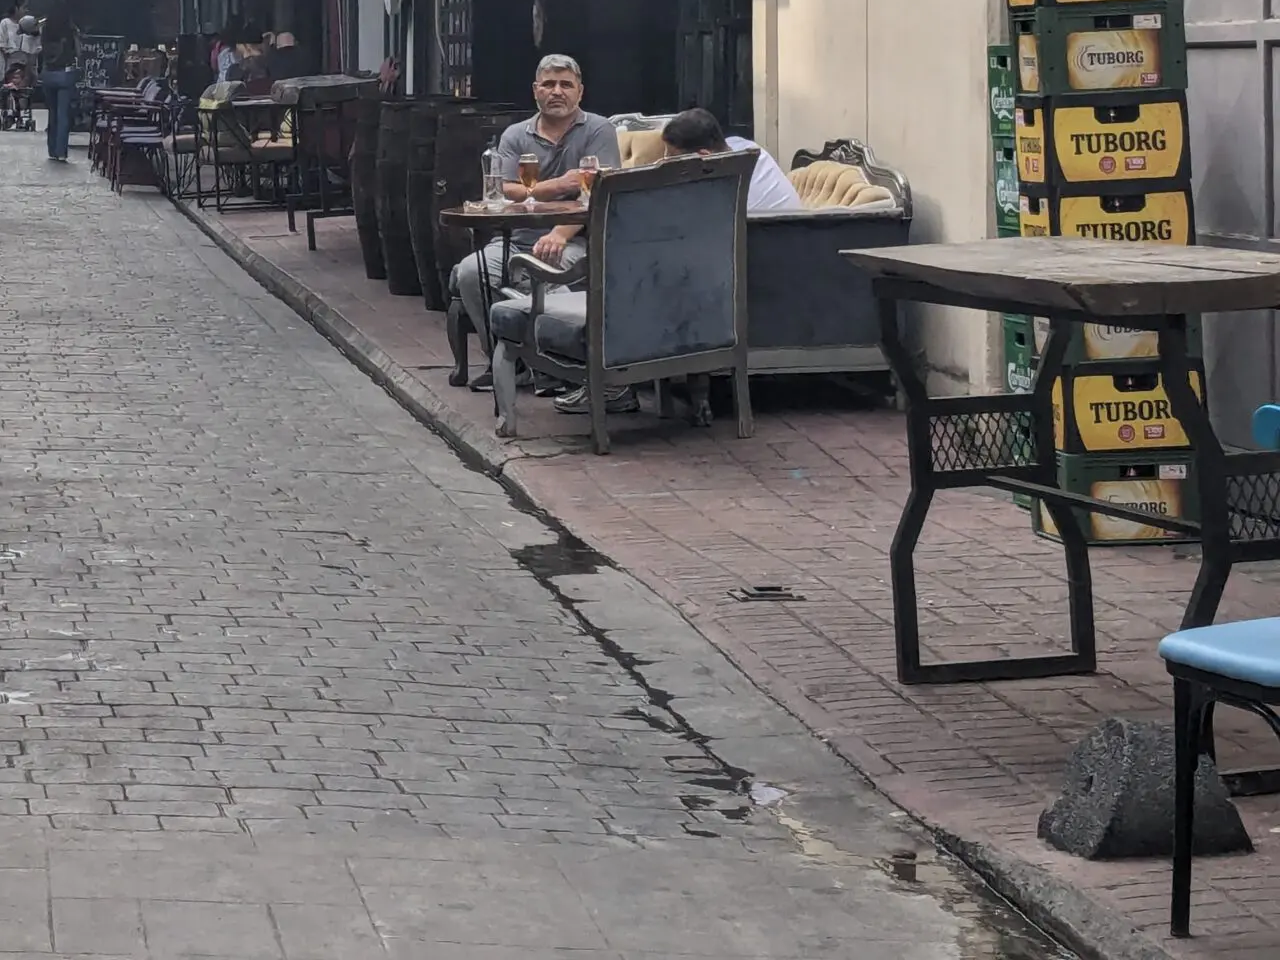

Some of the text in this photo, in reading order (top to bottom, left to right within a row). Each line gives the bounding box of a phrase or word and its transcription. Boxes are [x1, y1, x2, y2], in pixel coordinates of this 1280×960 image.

[1087, 51, 1144, 66] TUBORG
[1071, 129, 1166, 156] TUBORG
[1089, 400, 1171, 424] TUBOR
